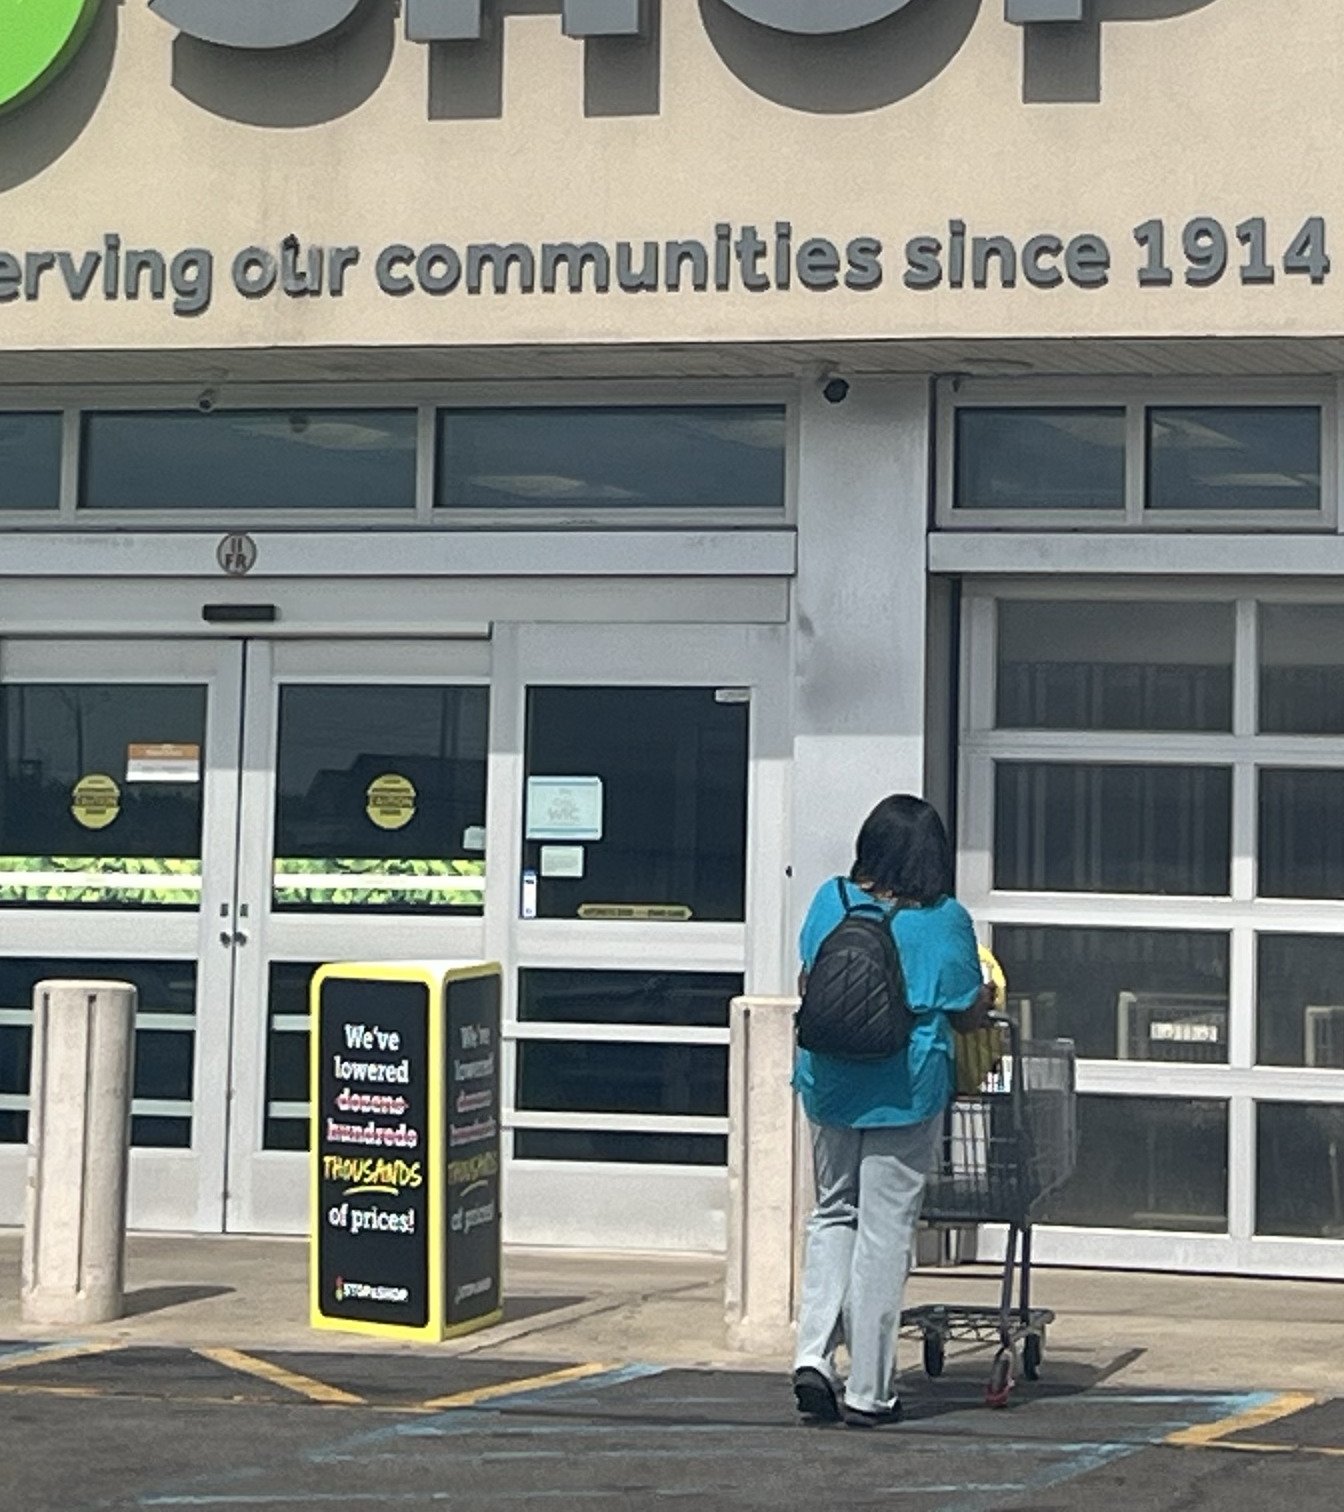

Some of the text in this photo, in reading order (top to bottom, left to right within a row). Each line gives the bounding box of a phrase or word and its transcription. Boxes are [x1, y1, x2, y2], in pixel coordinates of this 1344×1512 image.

[232, 240, 359, 299] our
[375, 222, 883, 299] communities
[903, 219, 1111, 291] since
[1132, 215, 1331, 287] 1914
[225, 553, 247, 569] FR
[333, 1055, 410, 1084] lowered
[336, 1087, 407, 1115] dozens
[327, 1117, 419, 1148] hundreds
[323, 1155, 423, 1188] THOUSANDS
[328, 1202, 416, 1234] of prices!
